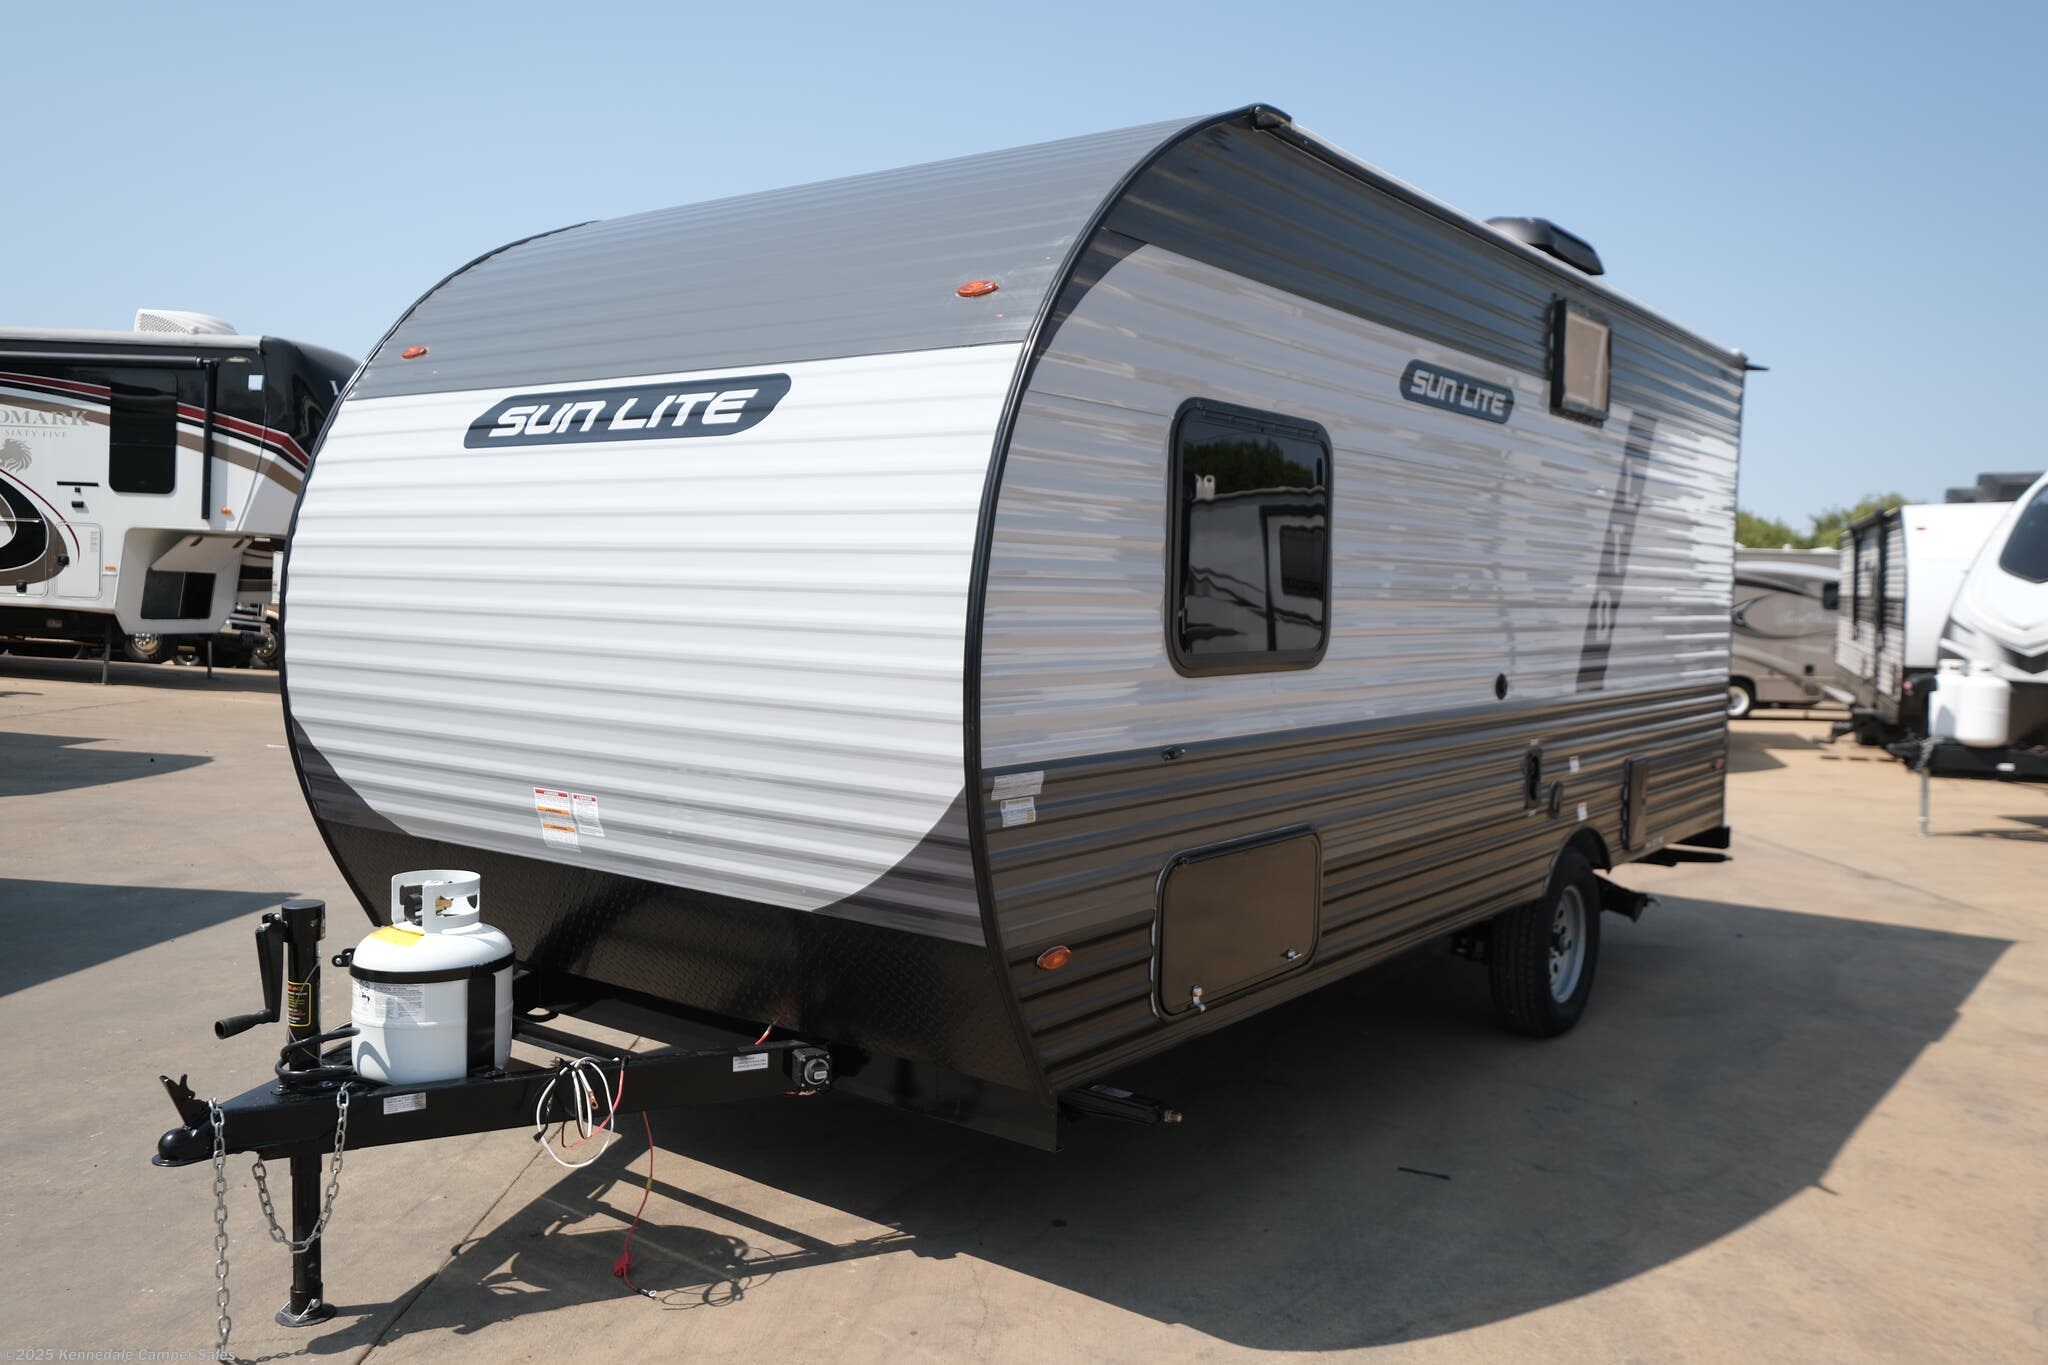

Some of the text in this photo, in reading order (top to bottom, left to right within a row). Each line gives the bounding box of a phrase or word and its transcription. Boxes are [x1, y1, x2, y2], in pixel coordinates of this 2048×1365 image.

[488, 388, 759, 437] SUN LITE
[1410, 369, 1507, 416] SUN LITE
